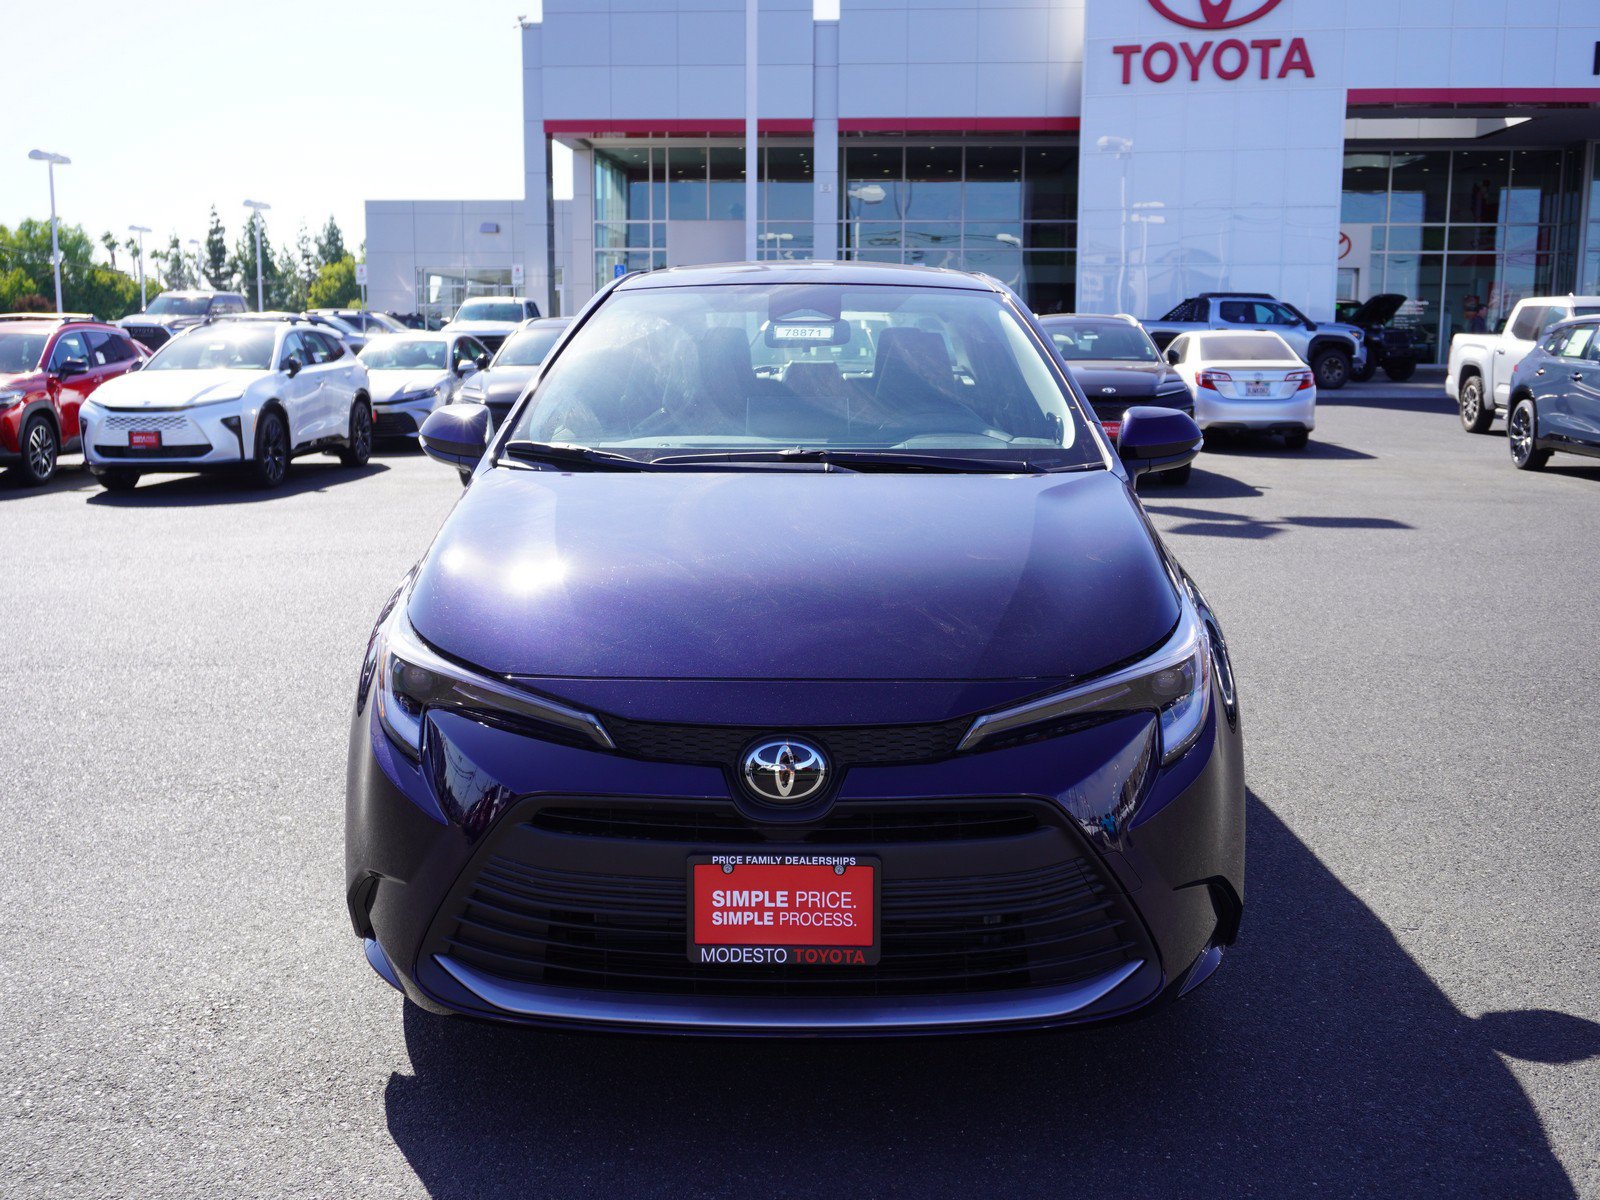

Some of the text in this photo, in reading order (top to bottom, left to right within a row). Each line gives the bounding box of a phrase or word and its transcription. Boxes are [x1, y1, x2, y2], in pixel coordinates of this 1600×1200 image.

[1113, 38, 1315, 84] TOYOTA
[784, 328, 823, 337] 78871
[712, 855, 856, 866] PRICE FAMILY DEALERSHIPS
[712, 890, 857, 909] SIMPLE PRICE.
[712, 911, 857, 927] SIMPLE PROCESS.
[701, 947, 865, 964] MODESTO TOYOTA
